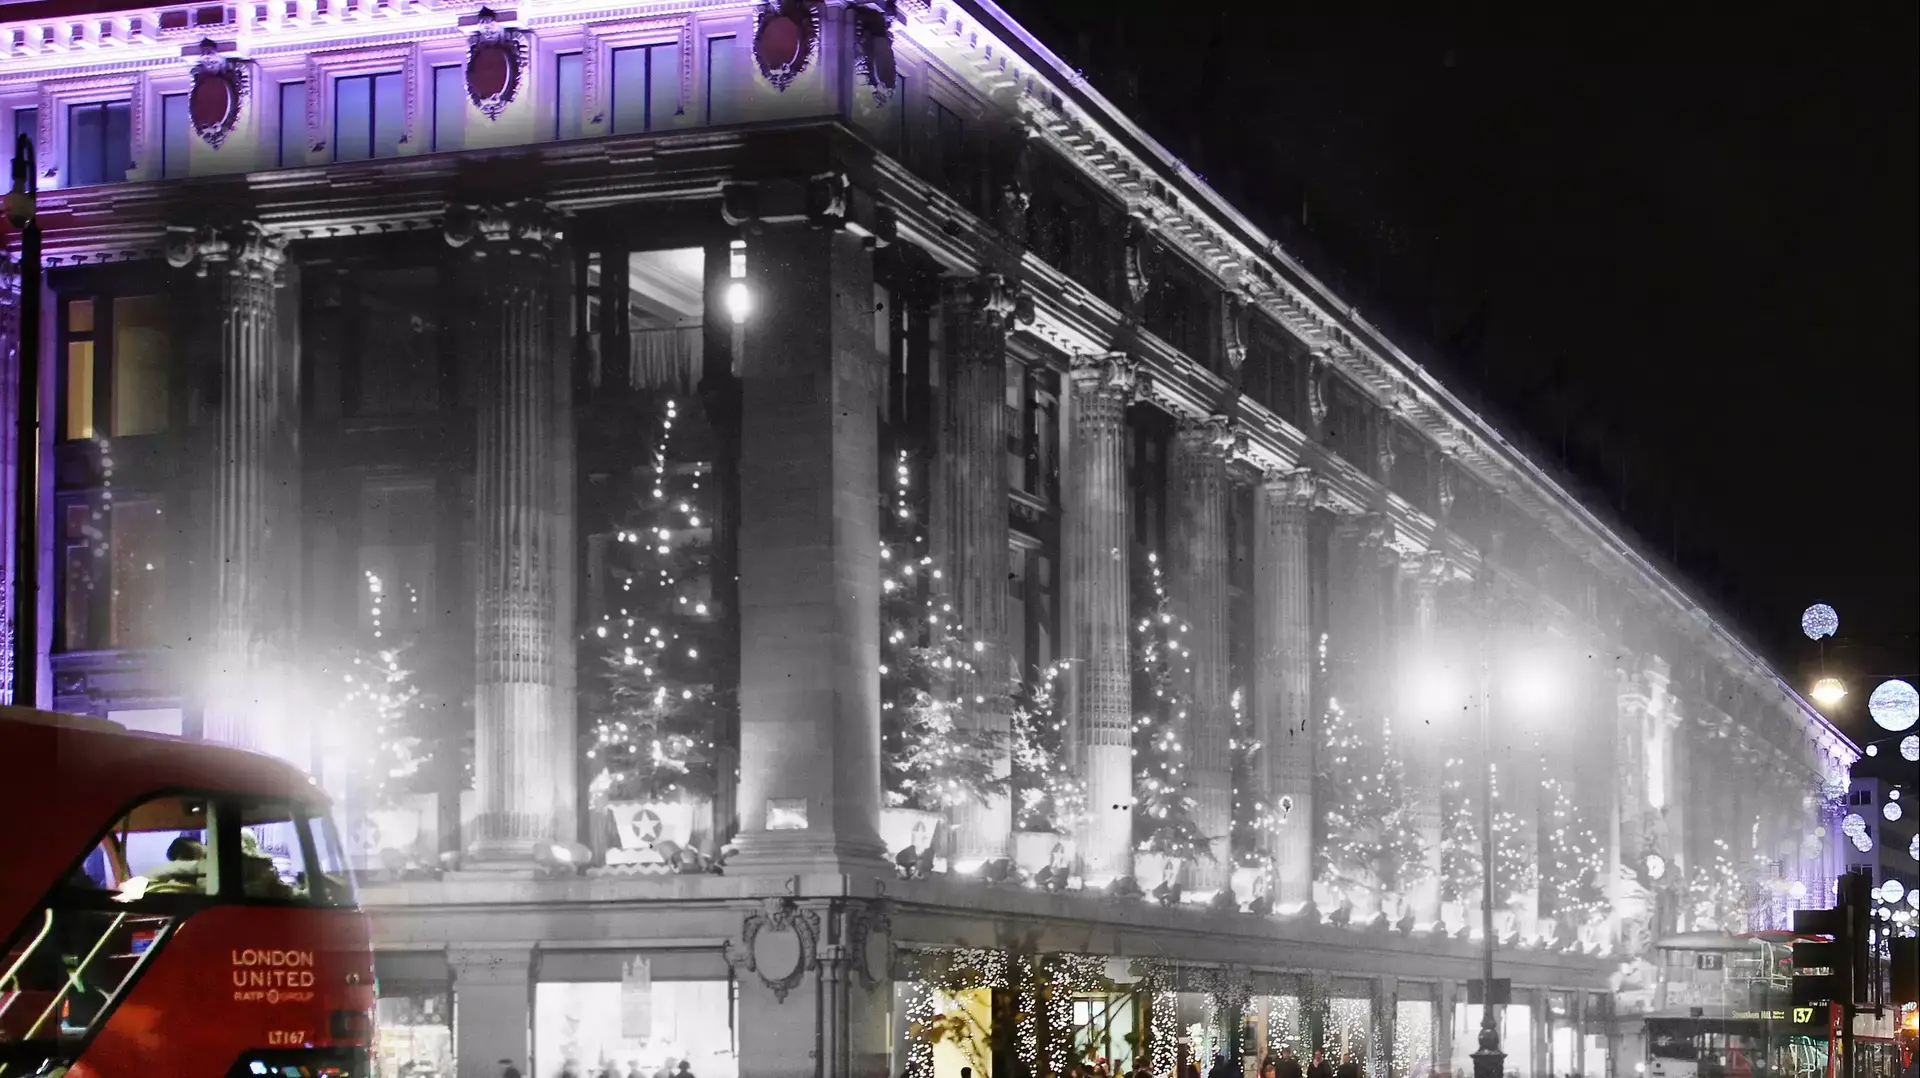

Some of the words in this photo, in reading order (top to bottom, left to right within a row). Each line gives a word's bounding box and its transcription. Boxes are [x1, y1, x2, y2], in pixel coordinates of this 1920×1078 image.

[232, 948, 314, 967] LONDON
[1701, 954, 1715, 969] 13
[233, 970, 315, 987] UNITED
[1793, 1007, 1813, 1023] 137
[268, 1031, 305, 1045] LT167
